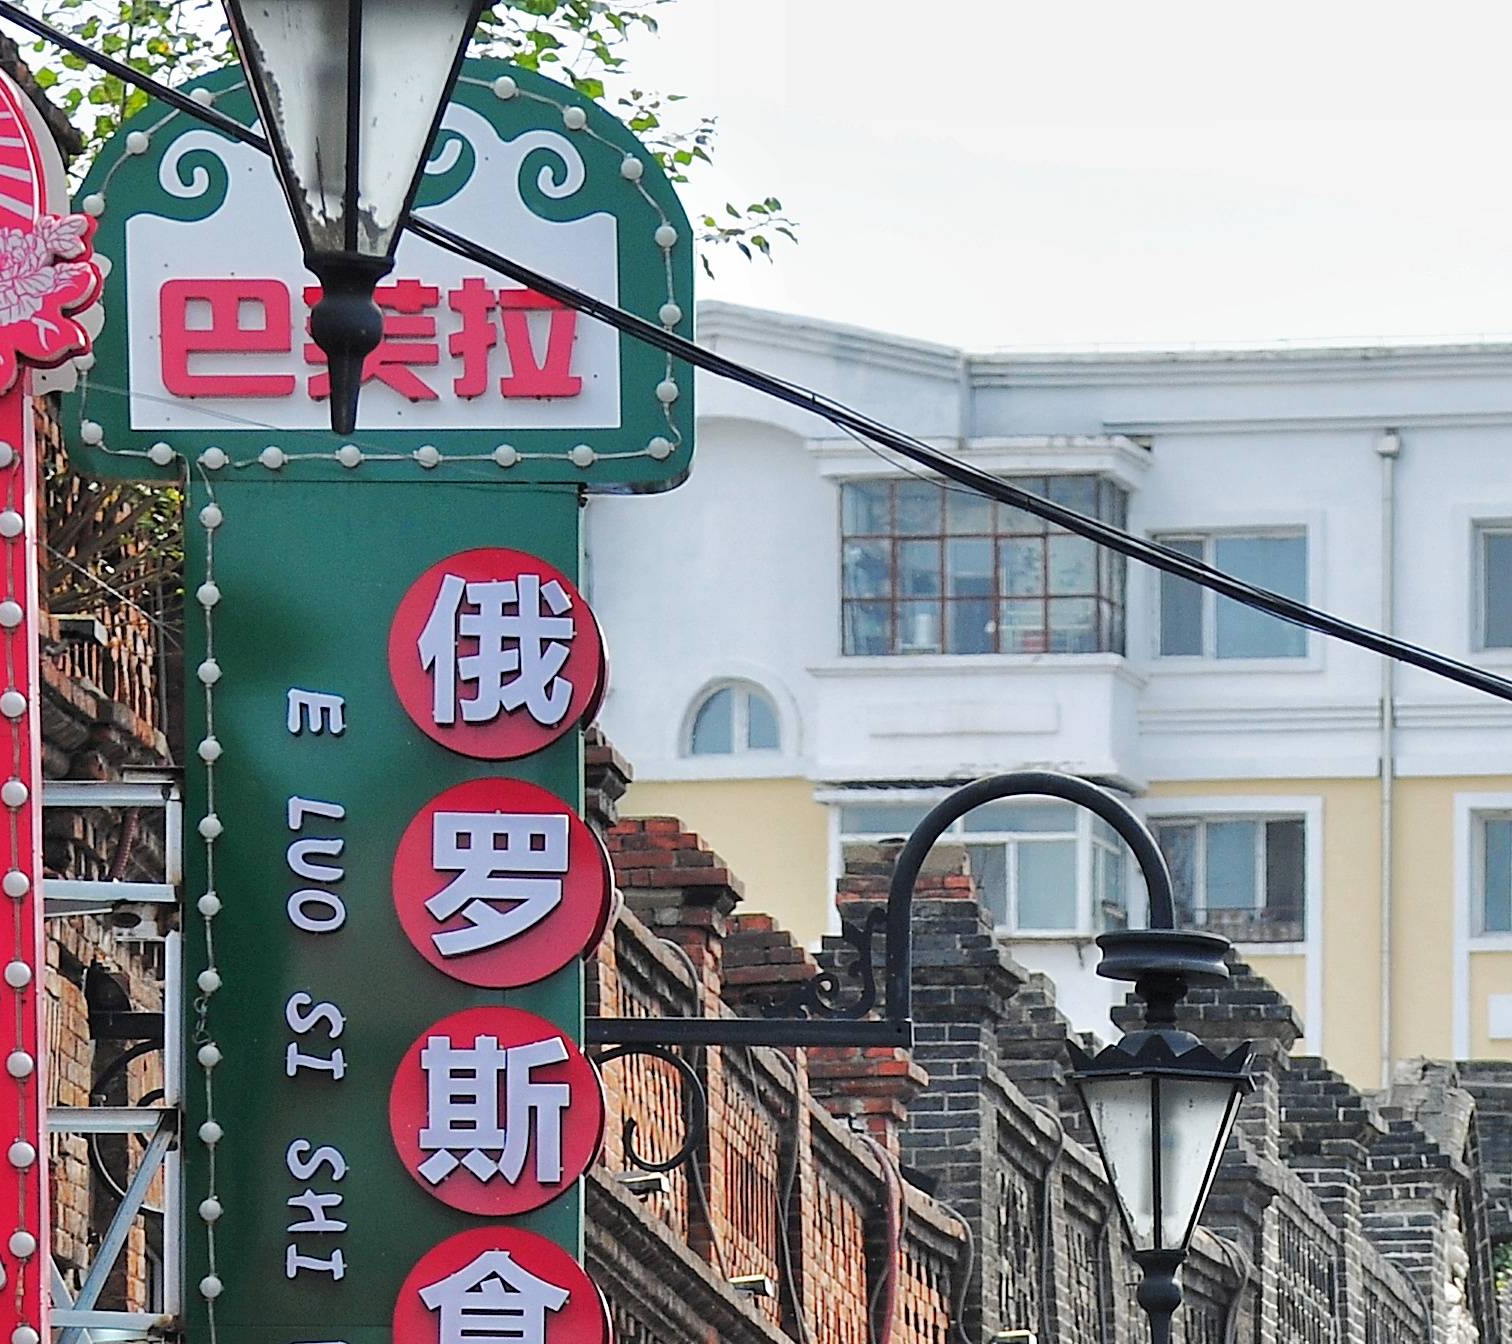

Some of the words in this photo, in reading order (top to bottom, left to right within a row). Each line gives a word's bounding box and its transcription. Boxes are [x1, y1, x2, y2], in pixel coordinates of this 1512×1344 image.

[286, 688, 346, 736] E
[286, 799, 346, 934] LUO
[285, 992, 346, 1082] SI
[285, 1138, 346, 1282] SHI
